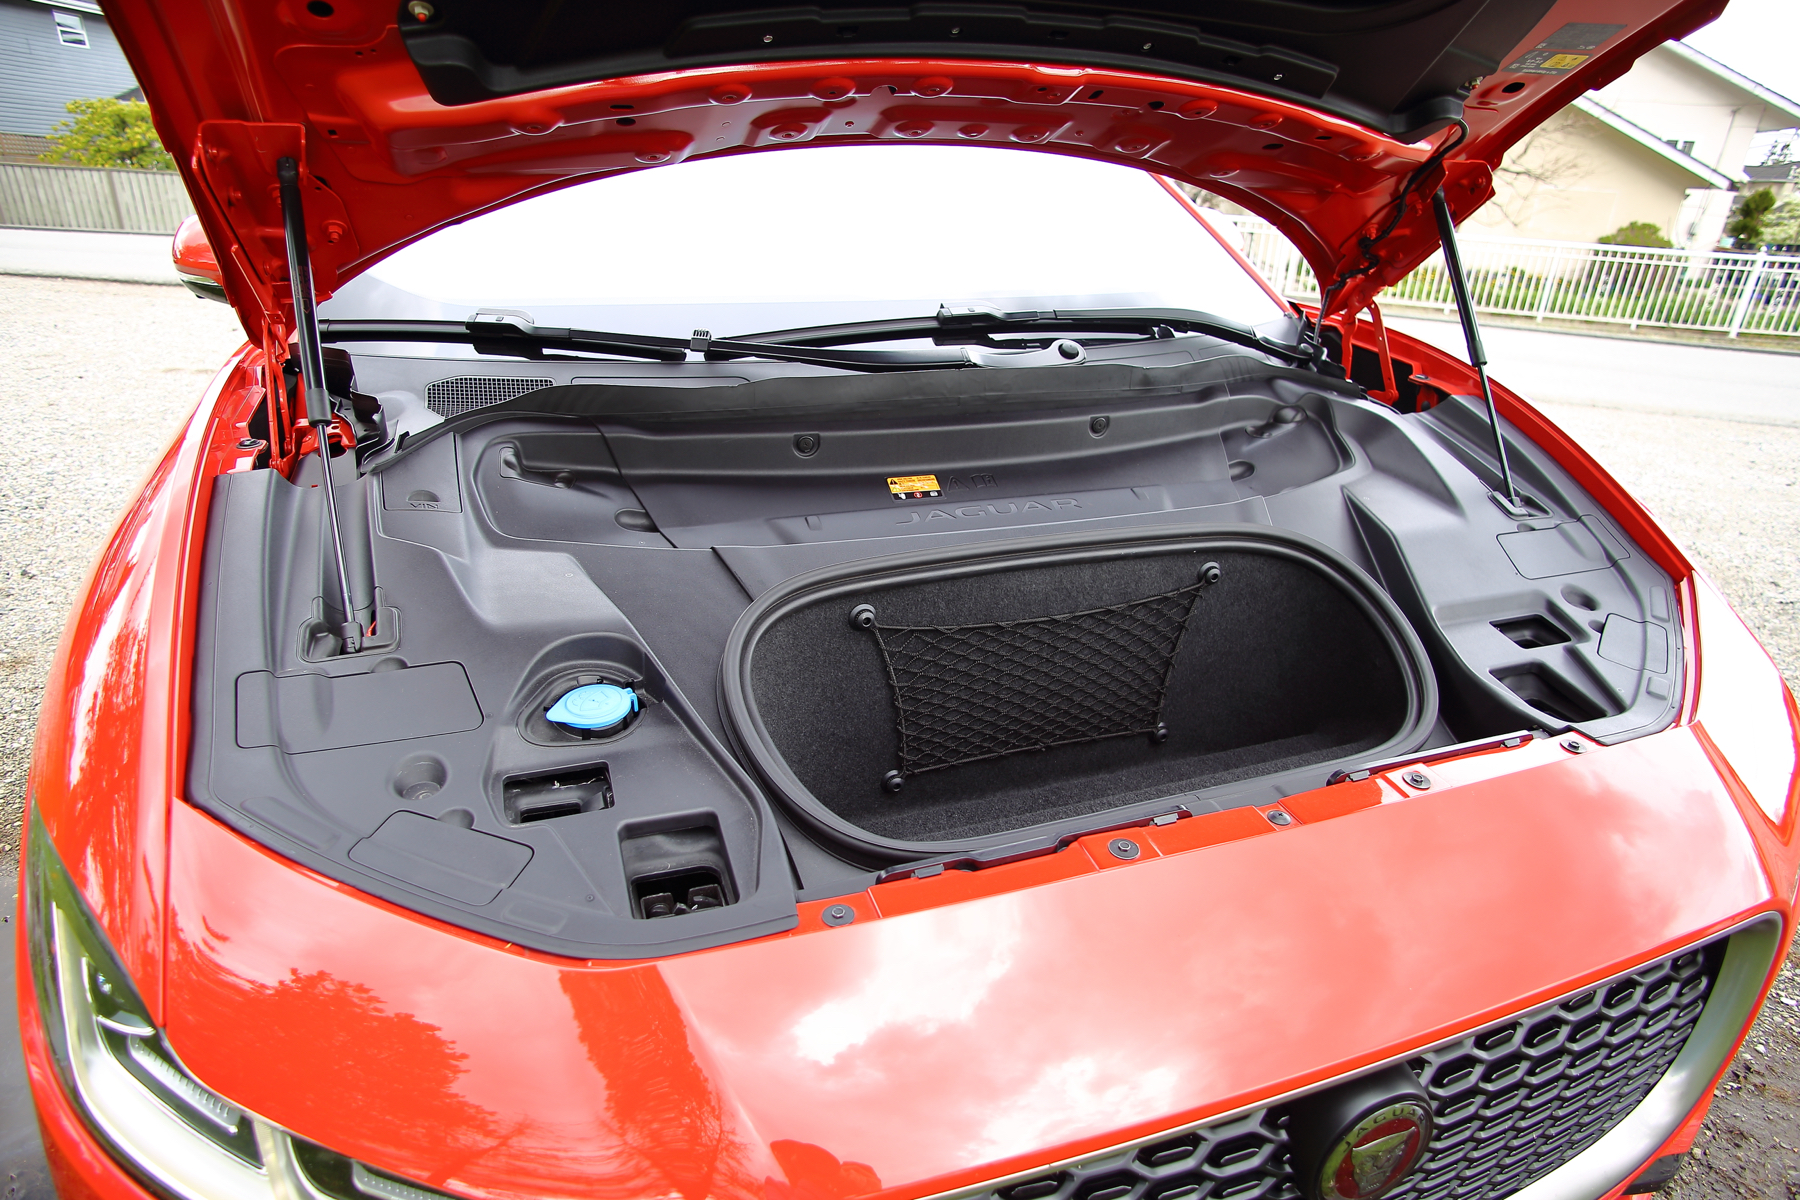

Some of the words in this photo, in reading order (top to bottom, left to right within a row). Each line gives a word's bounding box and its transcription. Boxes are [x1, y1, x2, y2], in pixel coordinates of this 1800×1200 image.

[409, 502, 440, 510] VIN
[896, 498, 1082, 526] JAGUAR
[1342, 1107, 1426, 1153] JAGUAR
